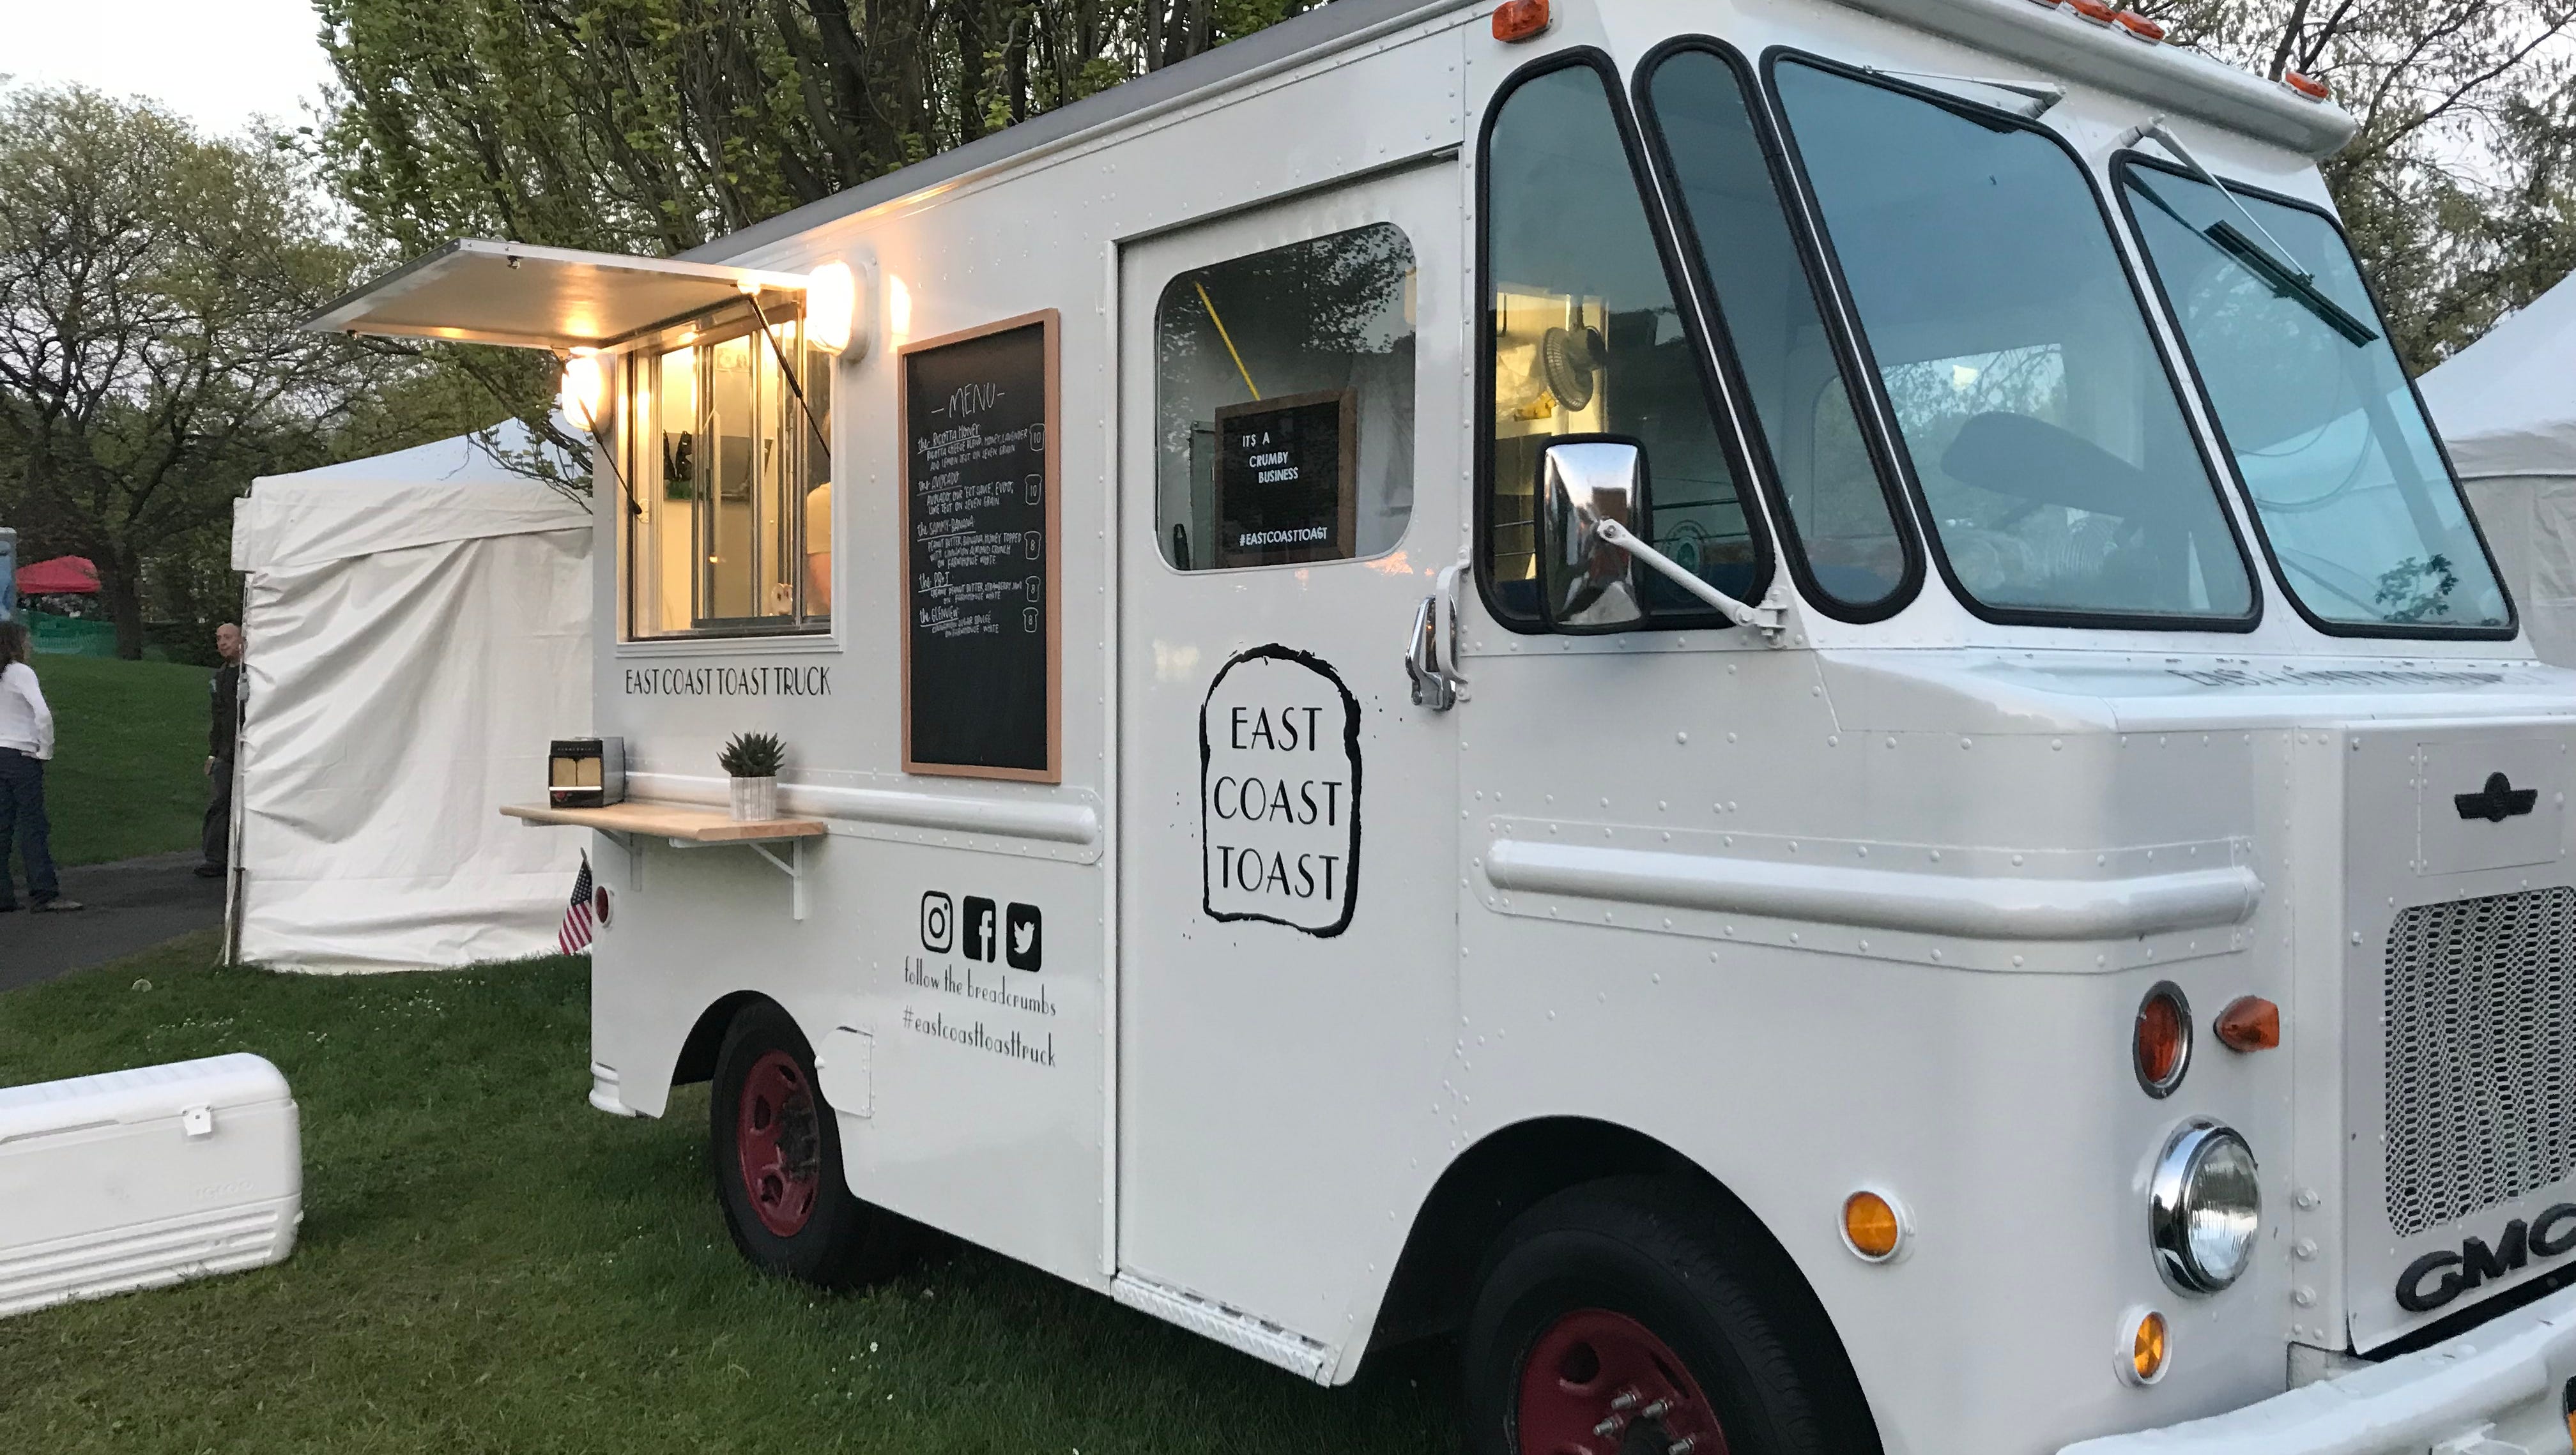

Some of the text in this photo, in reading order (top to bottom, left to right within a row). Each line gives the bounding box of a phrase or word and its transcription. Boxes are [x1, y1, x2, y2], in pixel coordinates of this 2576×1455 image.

[958, 423, 981, 439] HONEY
[1034, 431, 1041, 444] 10
[1243, 432, 1271, 448] ITS A
[1249, 451, 1289, 468] CRUMBY
[1258, 466, 1299, 484] BUSINESS
[1030, 484, 1038, 497] 10
[1030, 539, 1036, 551] 8
[1239, 526, 1328, 547] #EASTCOASTTOAST
[1031, 584, 1036, 595] 8
[1028, 614, 1033, 625] 8
[774, 666, 831, 696] TRUCK
[1231, 706, 1322, 751] EAST
[1213, 775, 1342, 826] COAST
[1216, 845, 1339, 900] TOAST
[905, 956, 1056, 1016] follow the breadcrumbs
[903, 1005, 1055, 1067] #eastcoasttoasttruck
[2396, 1203, 2576, 1311] GMC
